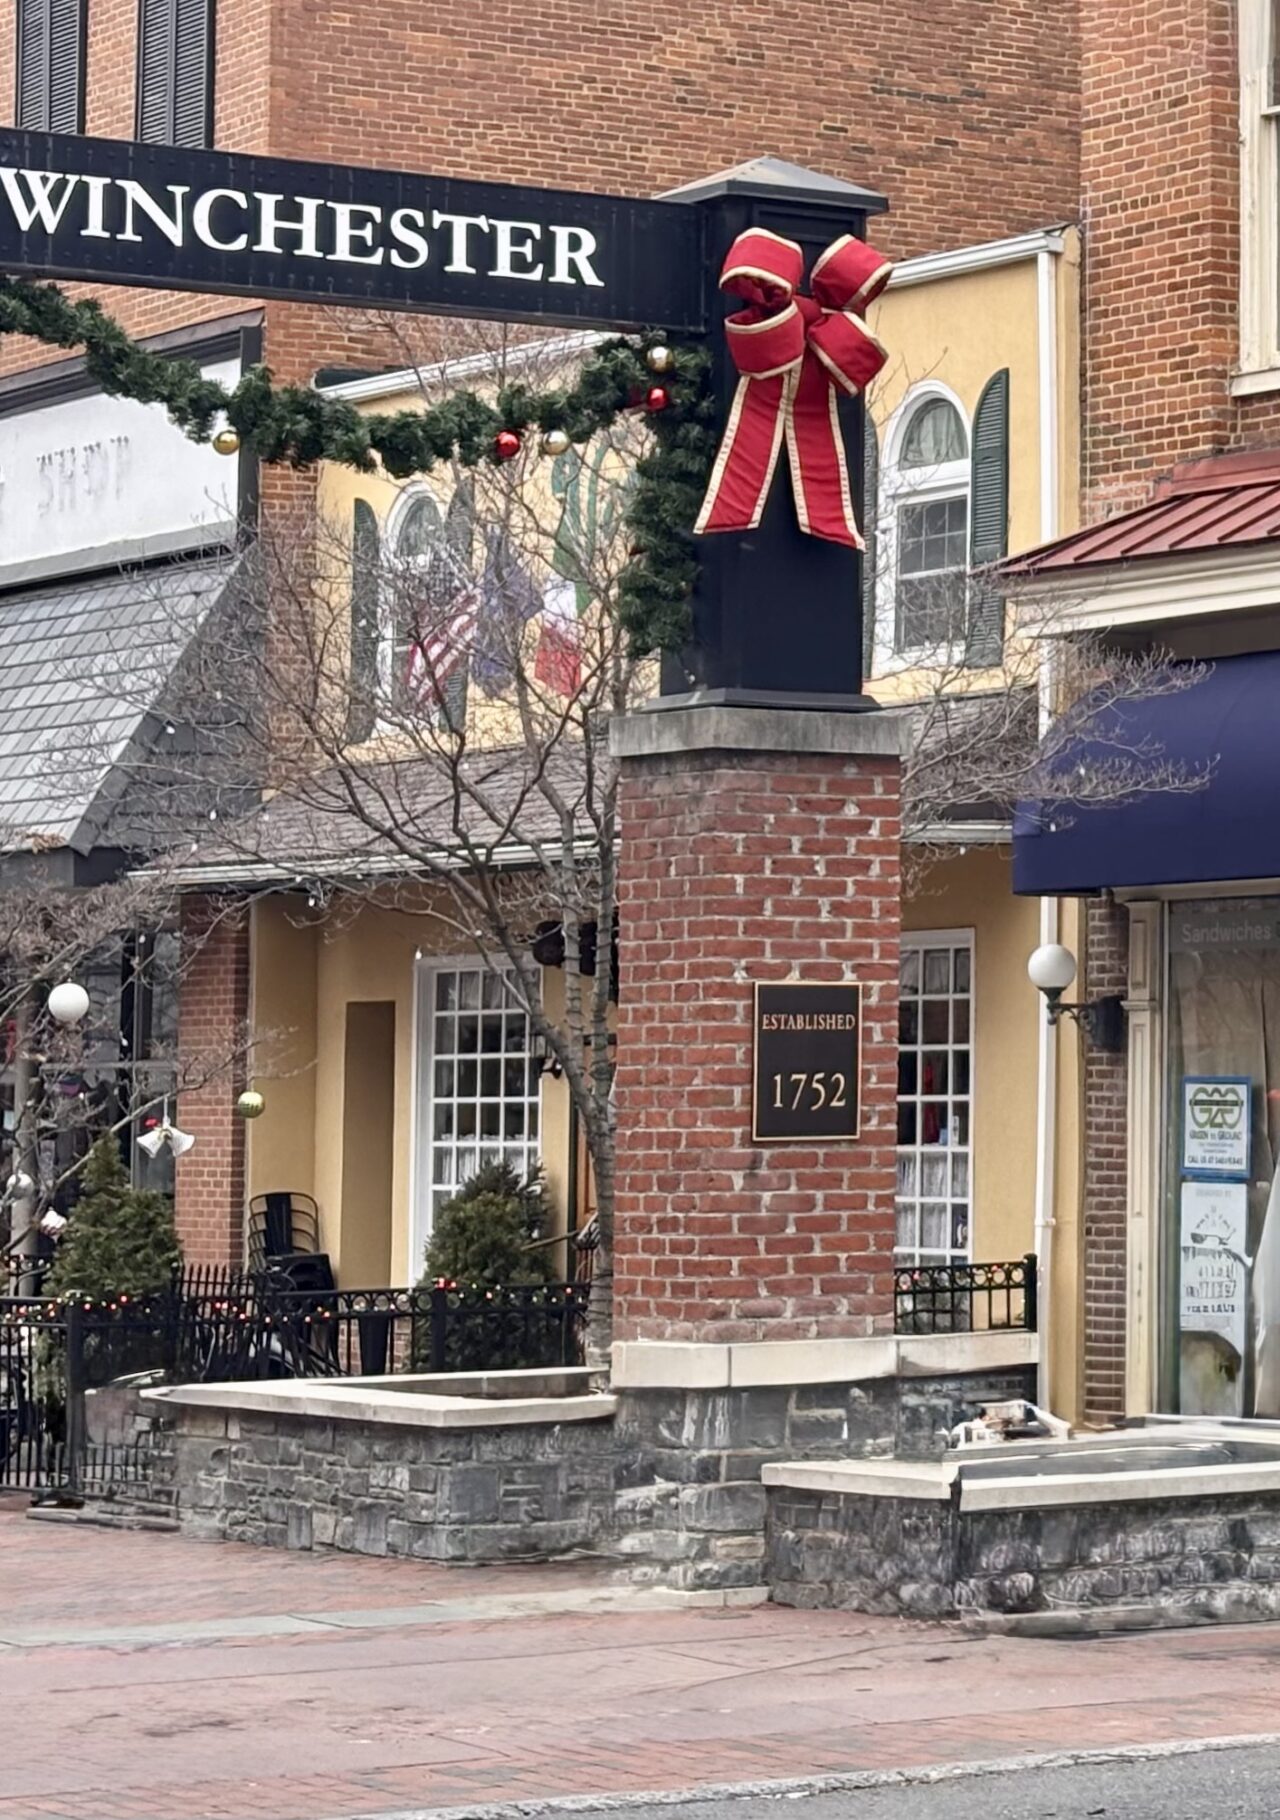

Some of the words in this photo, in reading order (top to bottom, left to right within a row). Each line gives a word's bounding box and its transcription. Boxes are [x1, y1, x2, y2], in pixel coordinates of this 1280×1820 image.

[0, 167, 605, 287] WINCHESTER
[1181, 919, 1272, 944] Sandwiches
[762, 1013, 856, 1030] ESTABLISHED
[773, 1072, 846, 1111] 1752
